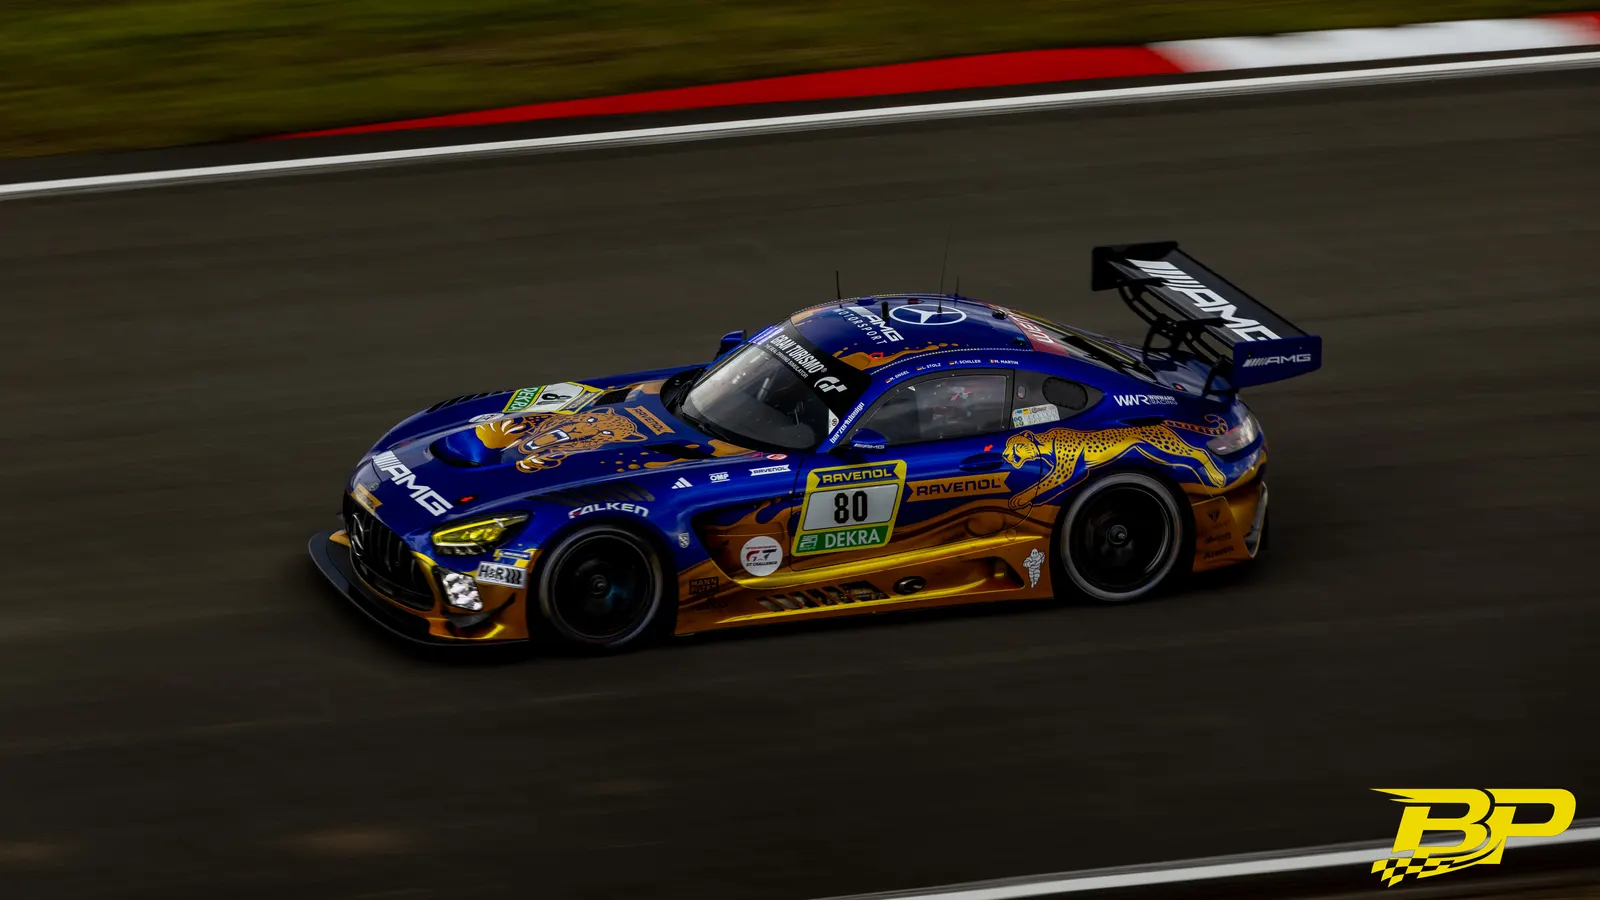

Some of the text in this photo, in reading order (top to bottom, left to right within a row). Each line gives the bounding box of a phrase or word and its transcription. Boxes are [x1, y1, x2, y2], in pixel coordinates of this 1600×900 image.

[833, 308, 888, 345] MOTORSPORT
[855, 311, 904, 342] AMG
[770, 334, 797, 351] GRAN
[1258, 353, 1312, 367] AMG
[709, 472, 730, 483] OMP
[753, 466, 787, 474] RAVENOL
[822, 464, 892, 484] RAVENOL
[377, 457, 454, 516] AMG
[916, 478, 1002, 496] RAVENOL
[567, 502, 649, 519] FALKEN
[834, 490, 868, 523] 80
[824, 528, 880, 549] DEKRA
